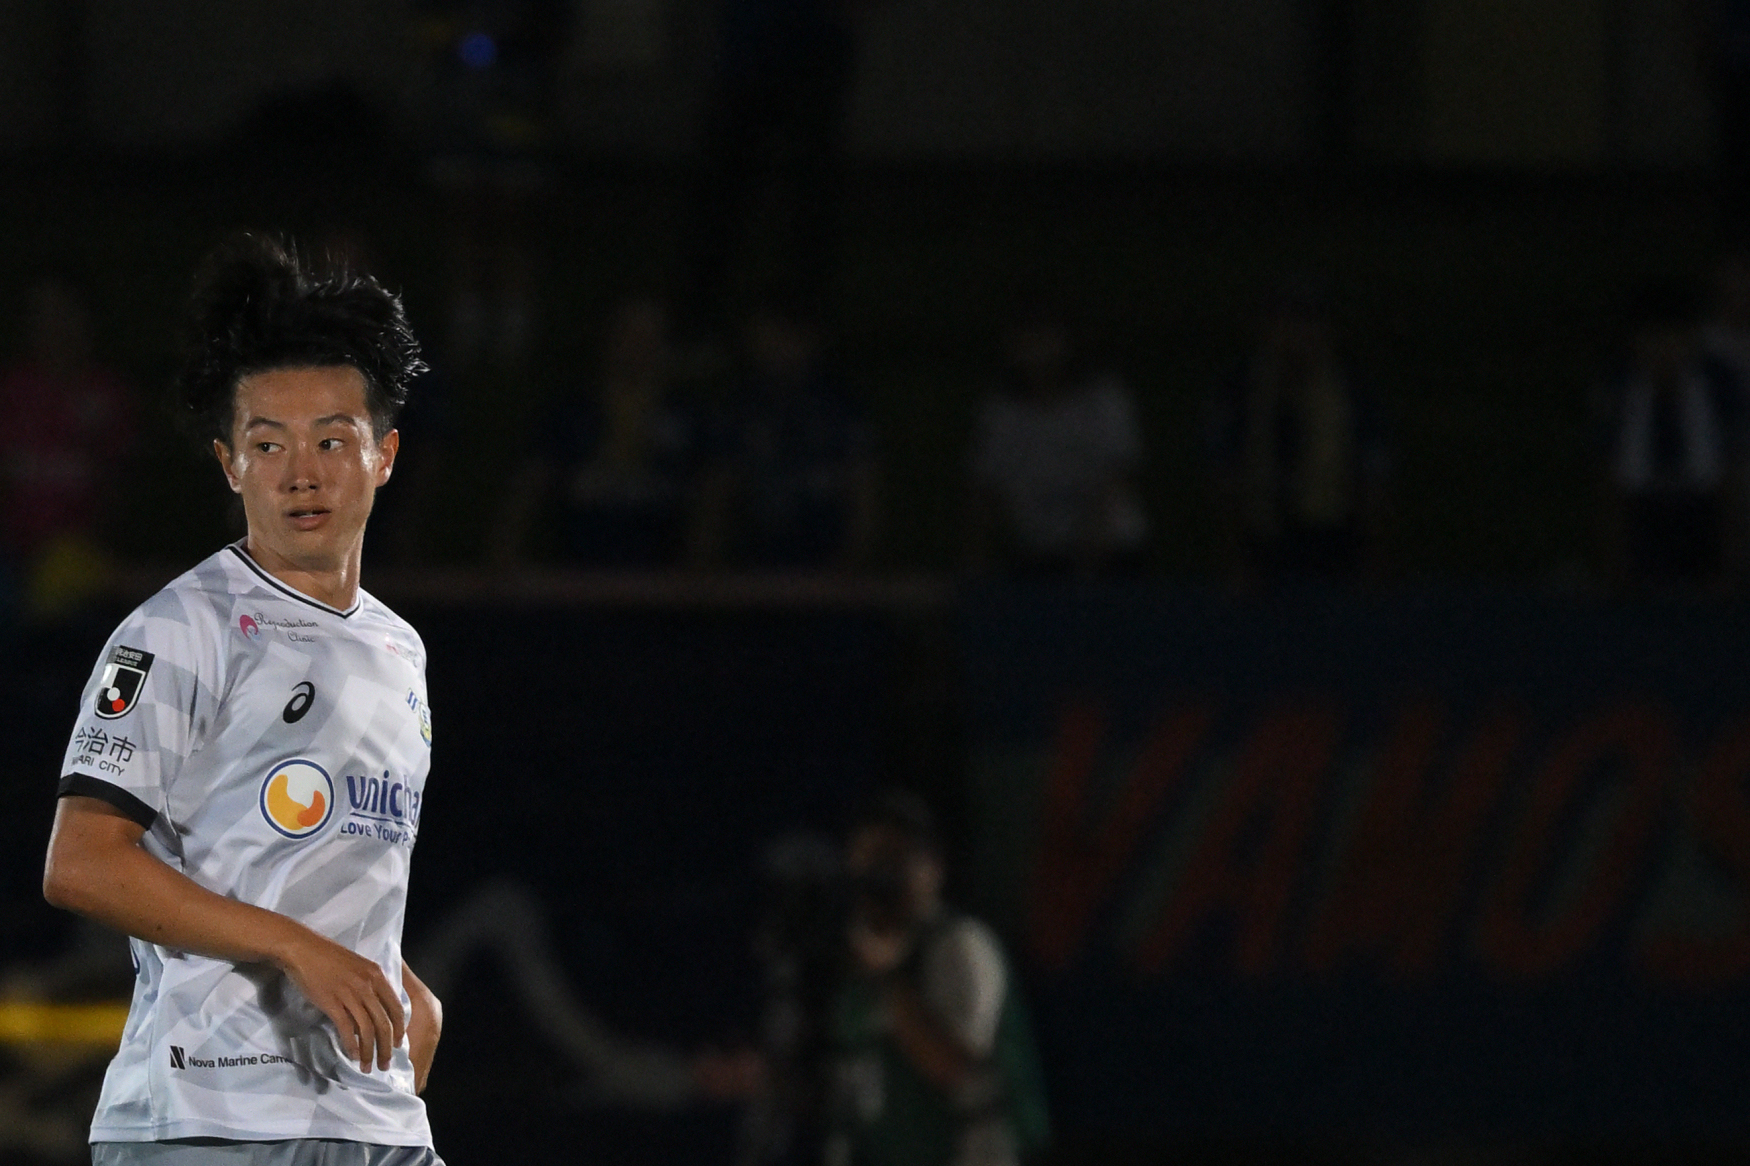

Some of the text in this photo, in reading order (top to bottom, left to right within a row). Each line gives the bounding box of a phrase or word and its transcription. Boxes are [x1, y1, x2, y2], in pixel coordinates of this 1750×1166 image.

[98, 760, 125, 776] CITY
[188, 1056, 216, 1068] Nova
[218, 1055, 257, 1068] Marine
